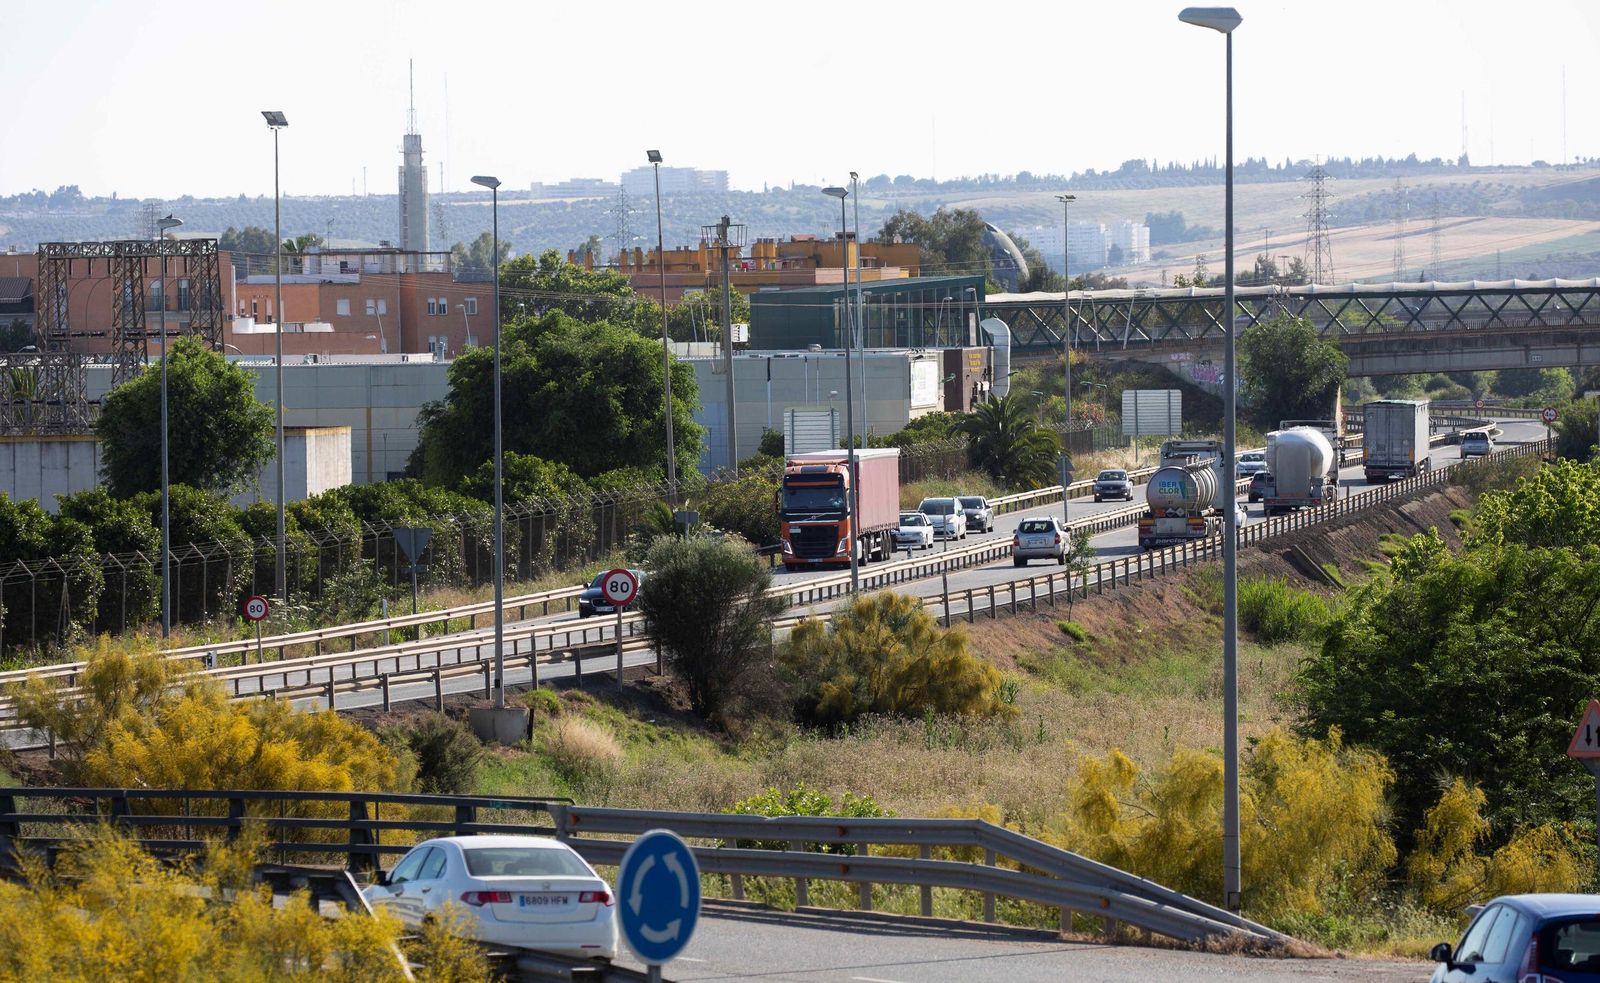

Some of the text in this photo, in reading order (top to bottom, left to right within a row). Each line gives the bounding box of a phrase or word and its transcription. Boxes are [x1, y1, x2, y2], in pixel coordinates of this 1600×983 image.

[610, 581, 629, 593] 80
[250, 604, 262, 613] 80
[526, 896, 548, 904] 6809
